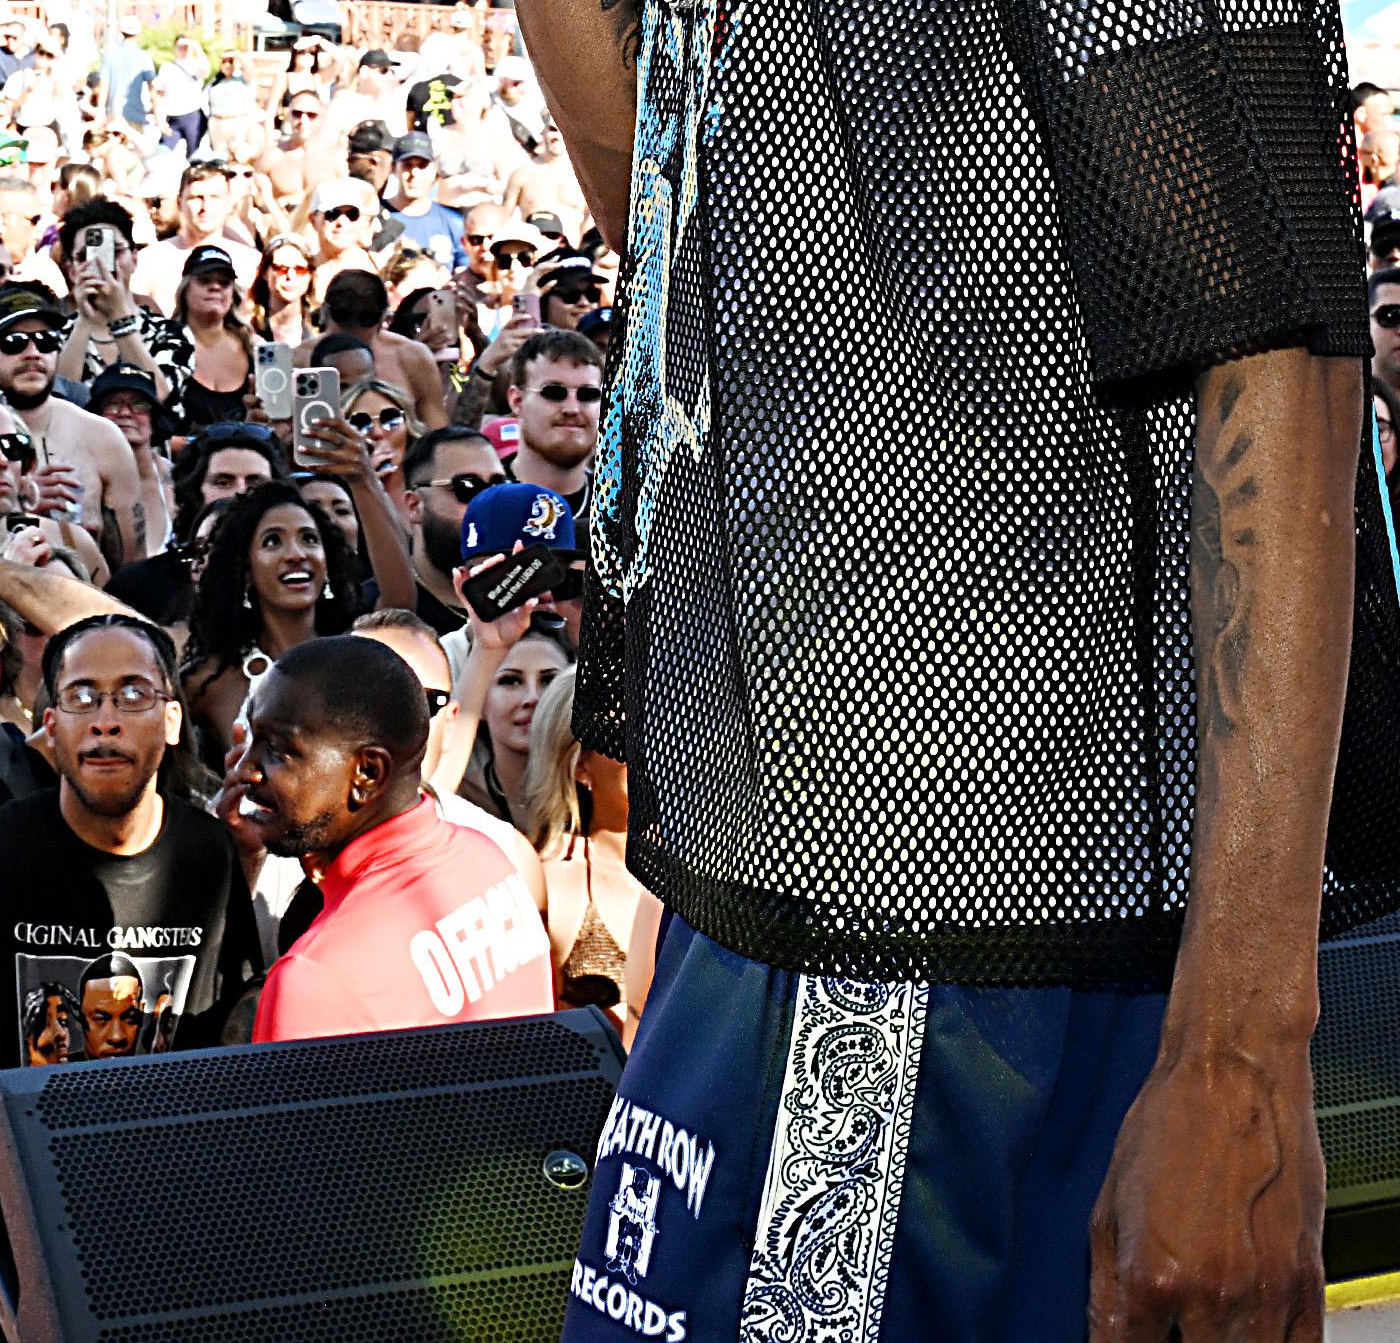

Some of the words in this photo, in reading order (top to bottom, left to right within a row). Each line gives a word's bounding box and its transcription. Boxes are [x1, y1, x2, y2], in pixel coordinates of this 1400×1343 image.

[14, 921, 101, 948] OIGINAL
[595, 1093, 663, 1166] EATH
[657, 1119, 716, 1220] ROW
[571, 1258, 687, 1343] RECORDS
